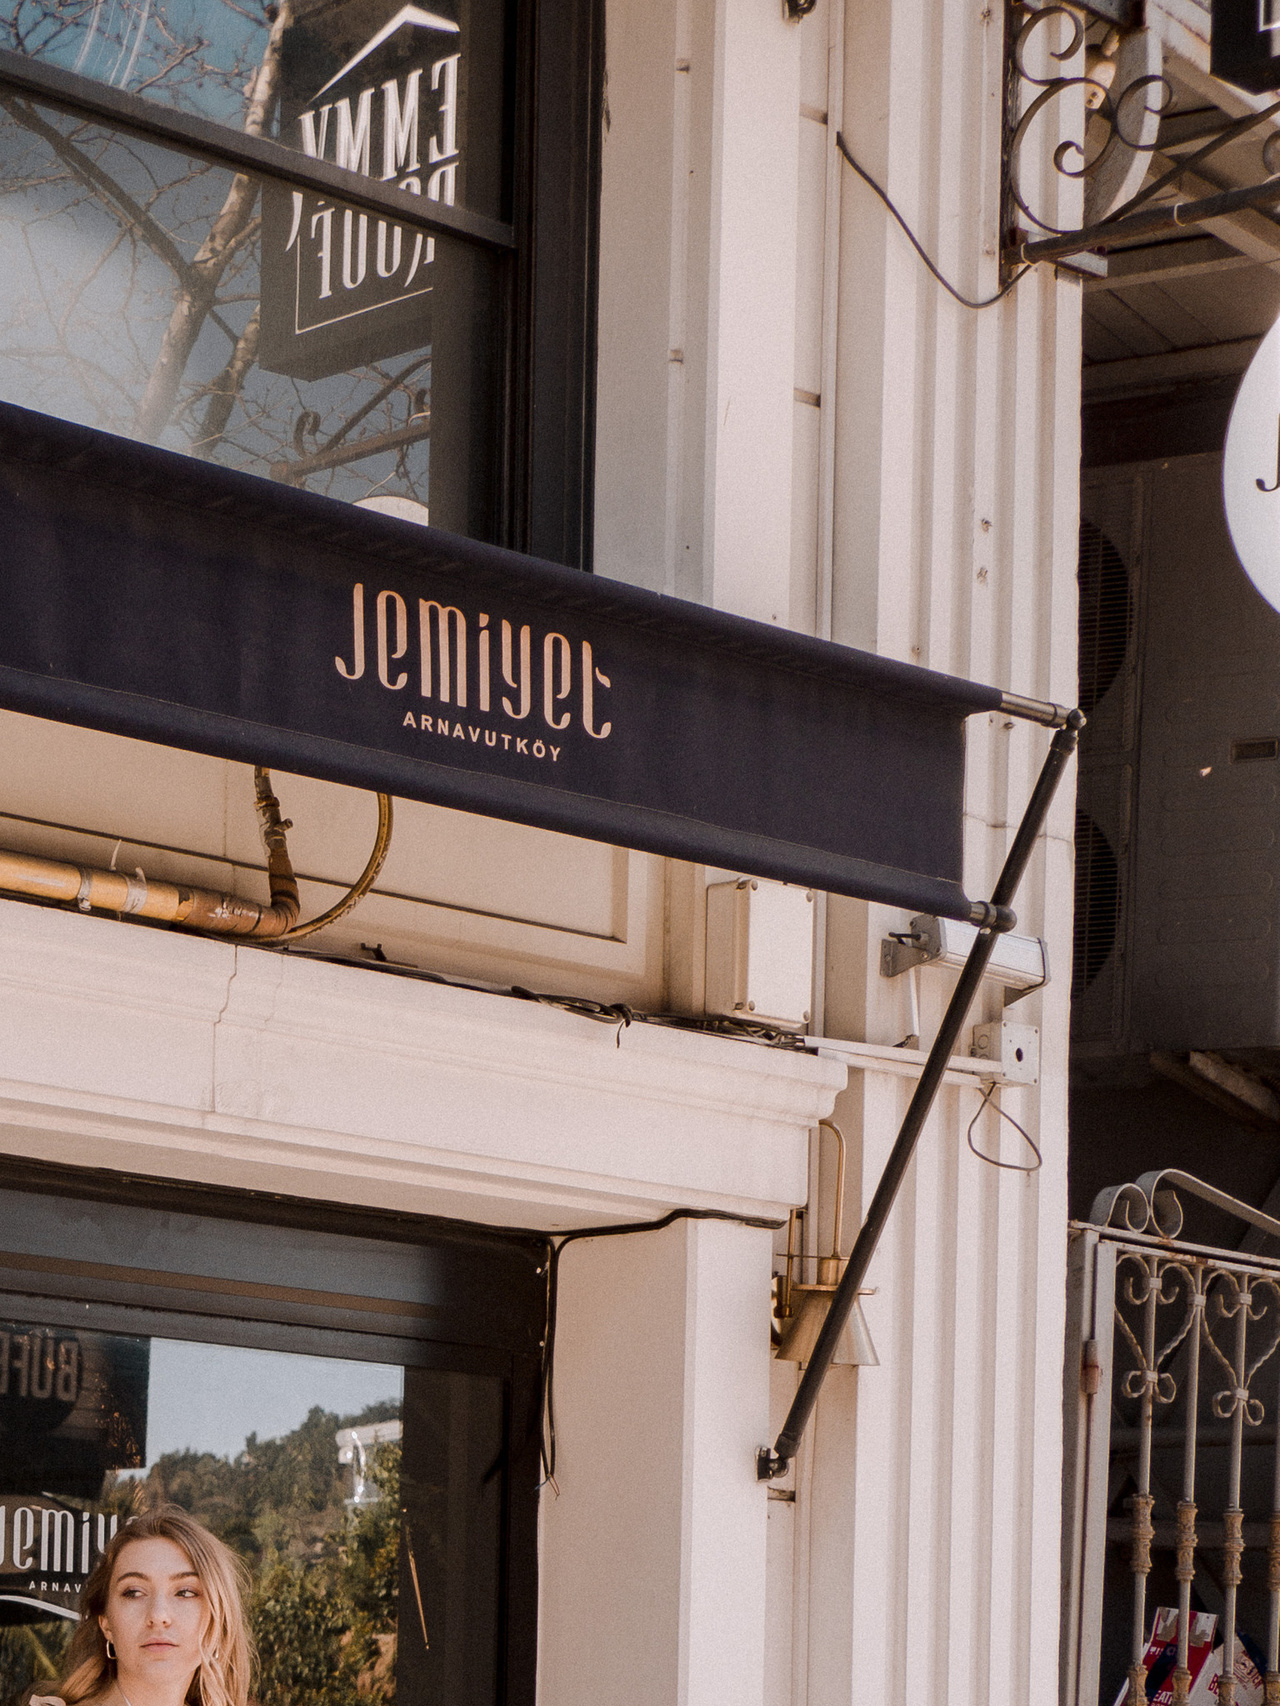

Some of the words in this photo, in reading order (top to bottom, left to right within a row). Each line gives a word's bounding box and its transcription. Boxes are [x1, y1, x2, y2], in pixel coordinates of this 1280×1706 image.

[335, 583, 612, 739] Jemiyet
[402, 711, 561, 762] ARNAVUTKÖY
[29, 1581, 82, 1593] ARNAV
